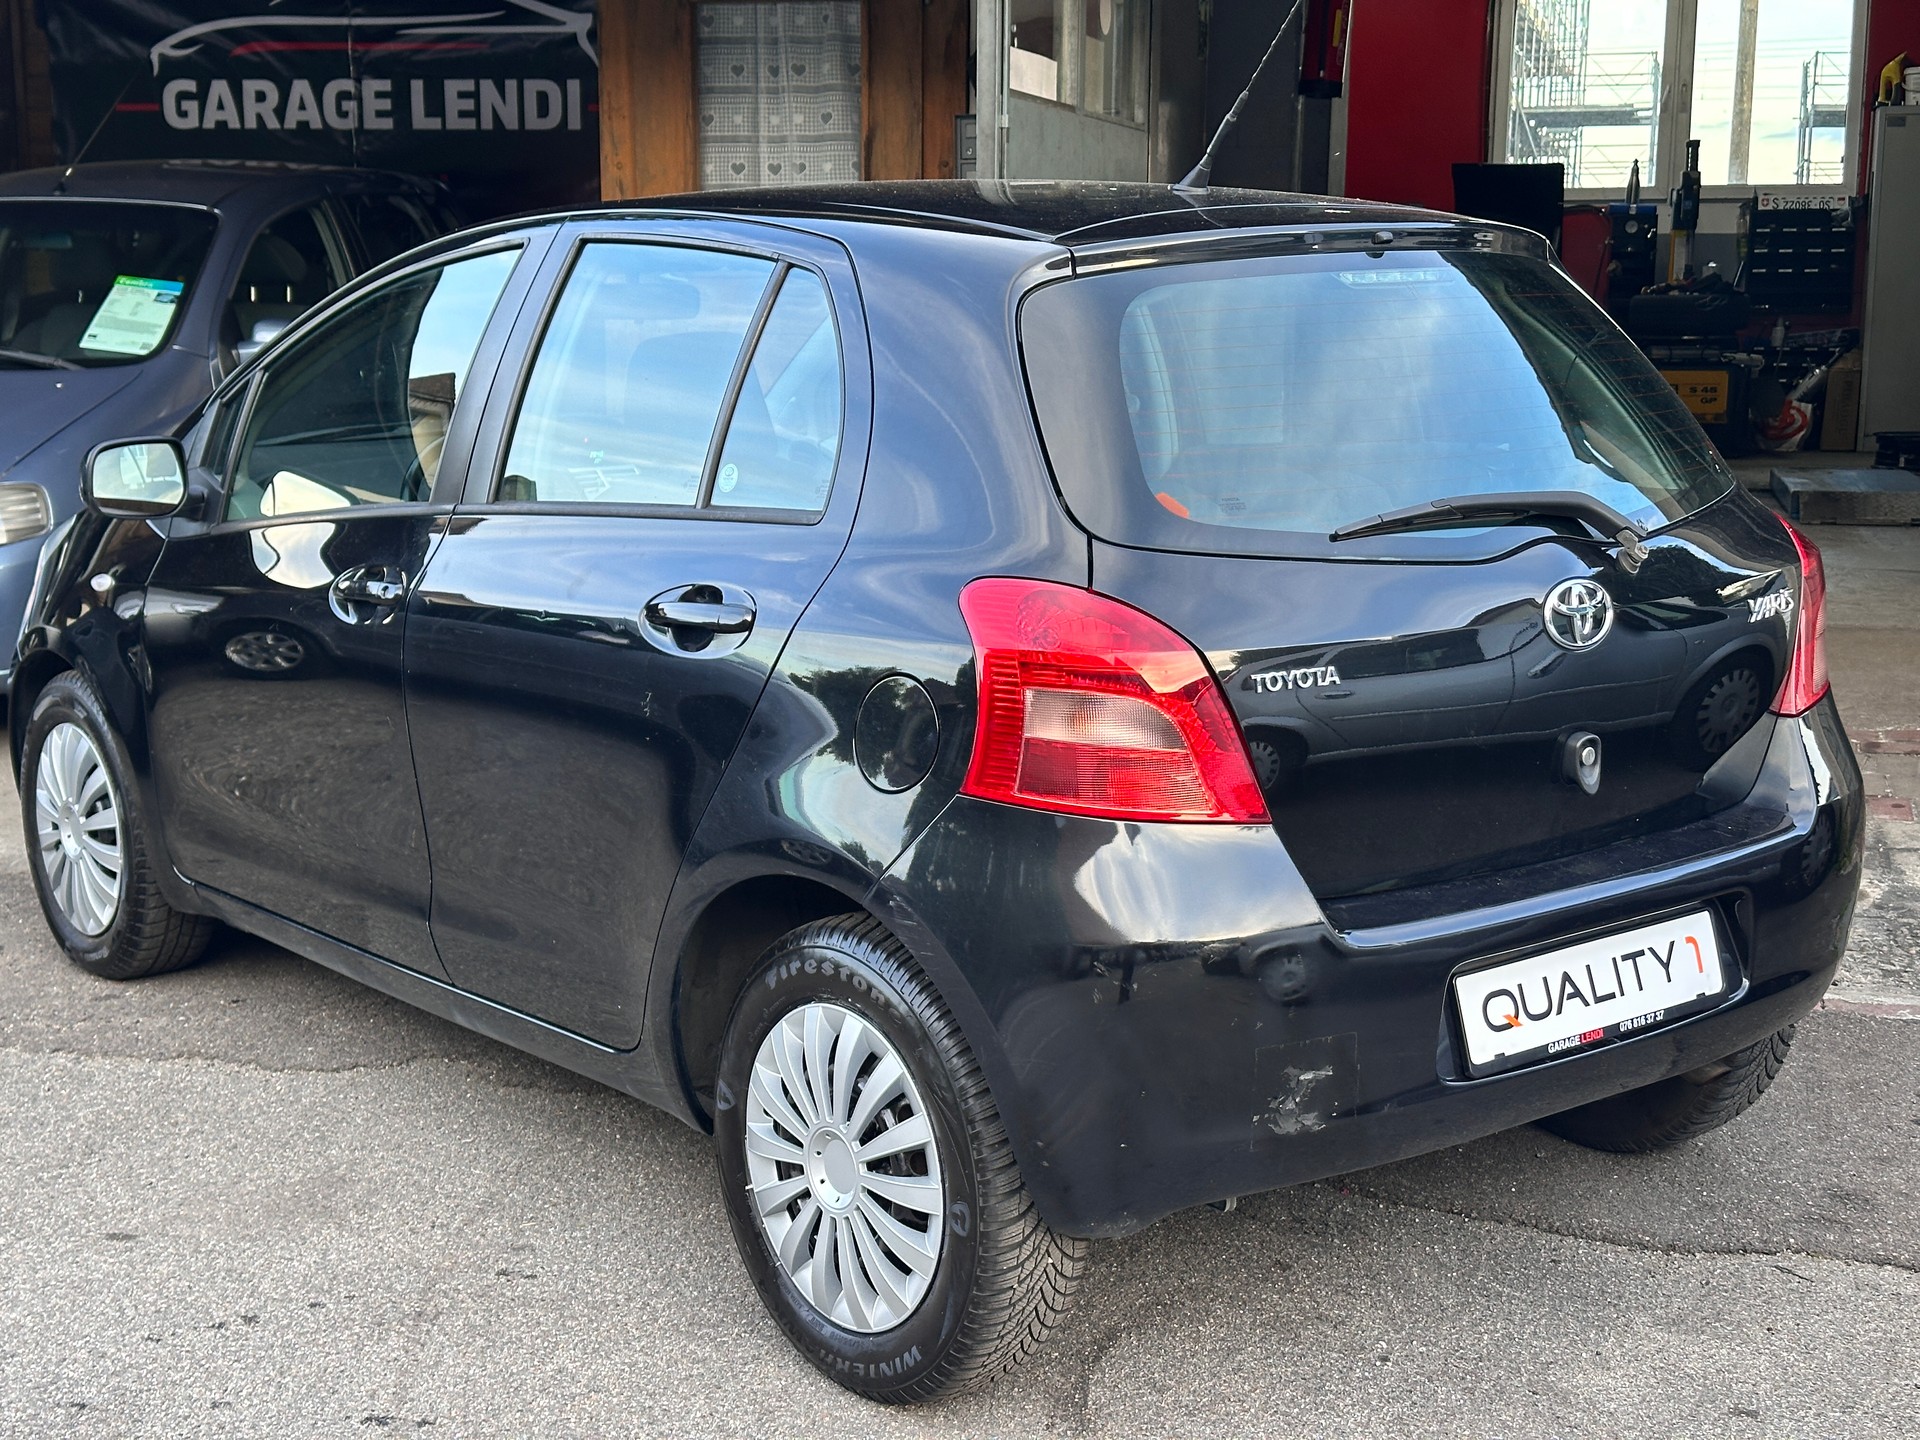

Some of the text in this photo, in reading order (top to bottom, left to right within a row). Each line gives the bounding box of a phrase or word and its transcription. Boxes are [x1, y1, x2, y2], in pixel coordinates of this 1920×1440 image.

[163, 79, 582, 130] GARAGE LENDI
[1747, 587, 1794, 623] YARIS
[1250, 665, 1341, 693] TOYOTA
[1482, 936, 1704, 1033] QUALITY 1
[1619, 1009, 1665, 1032] 076 816 37 37
[1547, 1028, 1604, 1053] GARAGE LENDI
